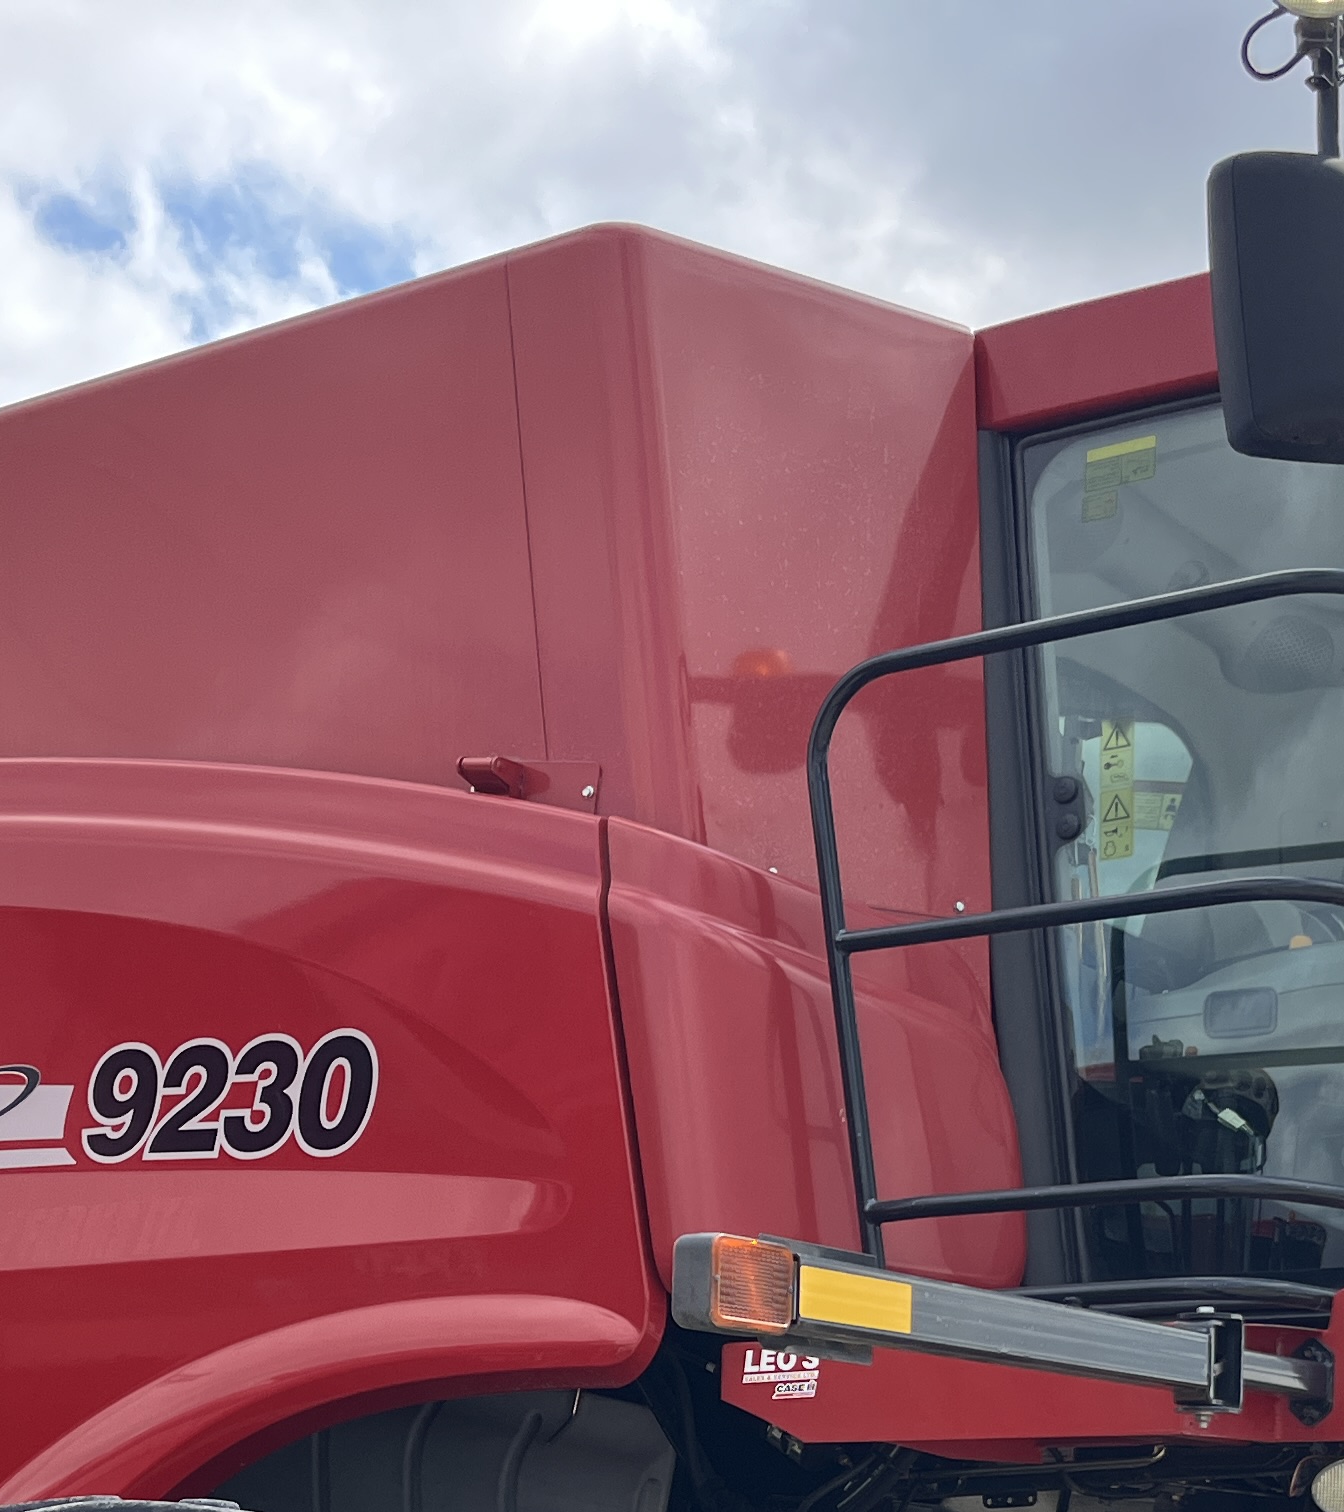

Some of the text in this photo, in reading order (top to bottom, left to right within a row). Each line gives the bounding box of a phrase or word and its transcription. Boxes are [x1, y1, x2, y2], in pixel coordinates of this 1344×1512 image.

[81, 1027, 379, 1164] 9230
[743, 1348, 820, 1373] LEOS
[776, 1383, 805, 1393] CASE
